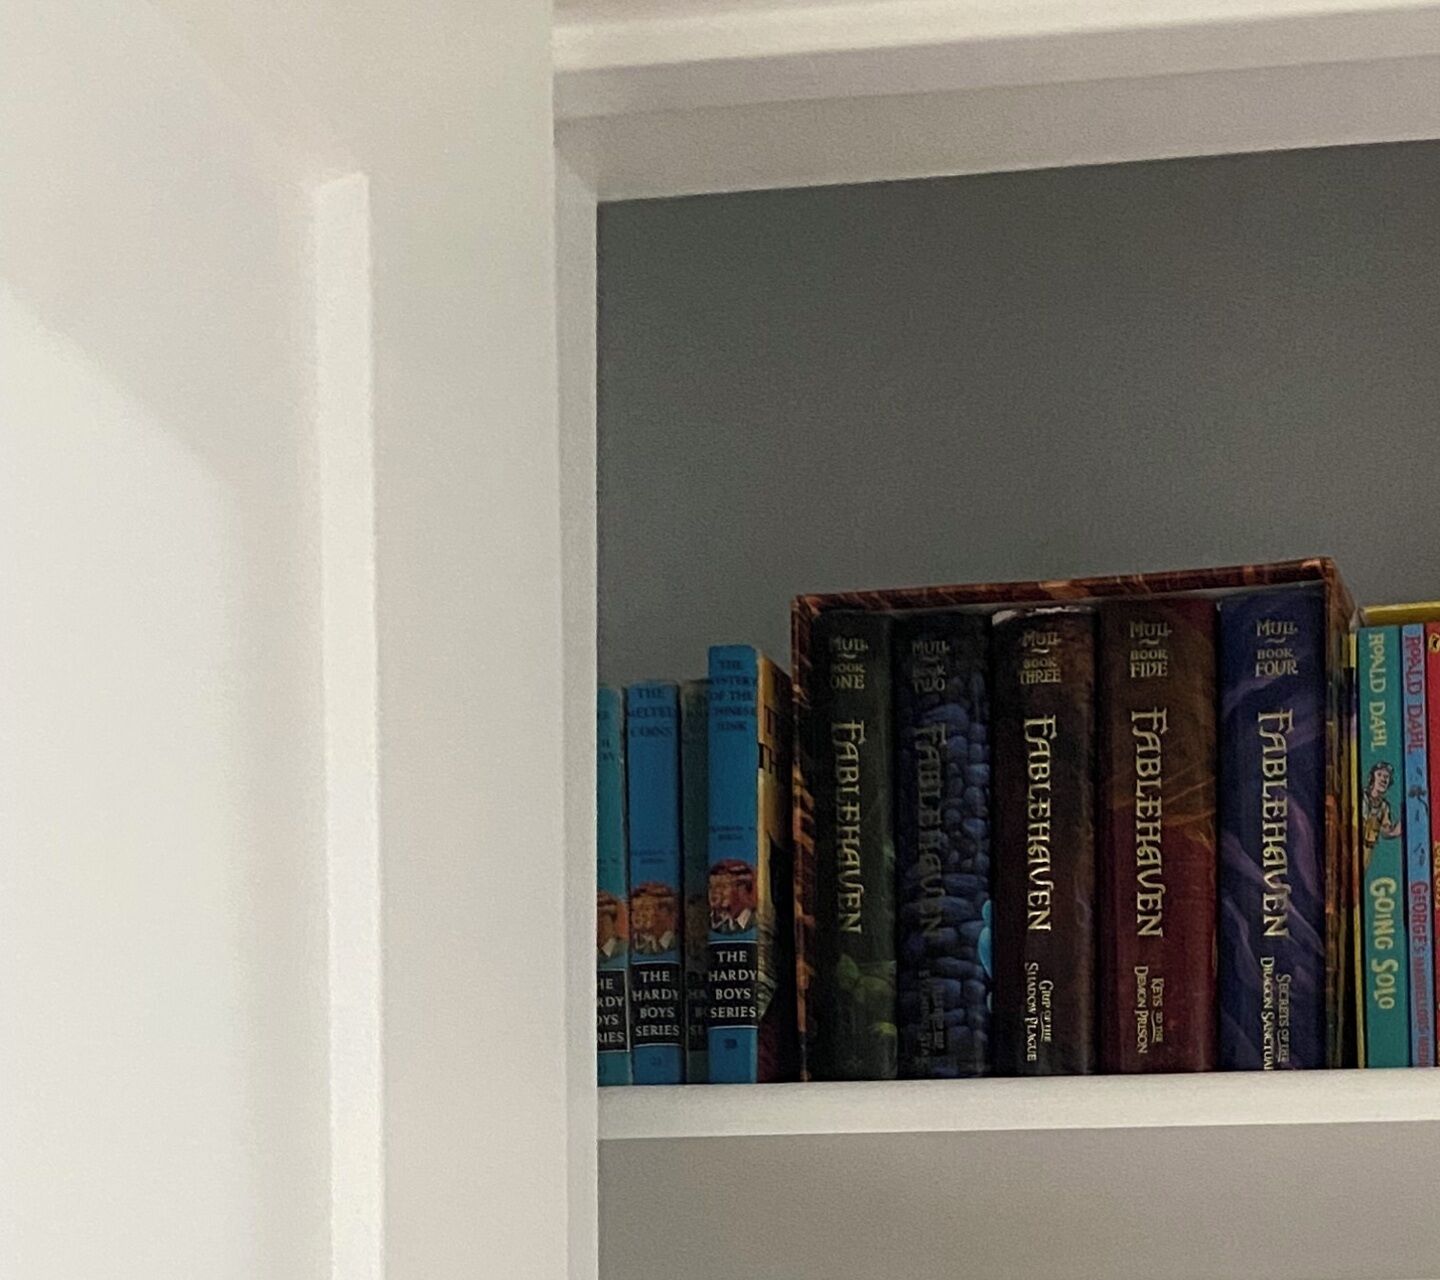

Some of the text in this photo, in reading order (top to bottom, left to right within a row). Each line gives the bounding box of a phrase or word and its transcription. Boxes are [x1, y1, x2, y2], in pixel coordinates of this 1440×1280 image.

[1256, 660, 1298, 677] FOUR
[1131, 706, 1169, 938] FABLEHAVEN
[1257, 706, 1295, 938] FABLEHAVEN
[1370, 877, 1398, 1010] GOING SOLO
[717, 950, 747, 964] THE
[640, 969, 670, 983] THE
[709, 969, 758, 983] HARDY
[715, 987, 751, 1001] BOYS
[640, 1006, 675, 1021] BOYS
[711, 1006, 757, 1020] SERIES
[636, 1024, 680, 1038] SERIES
